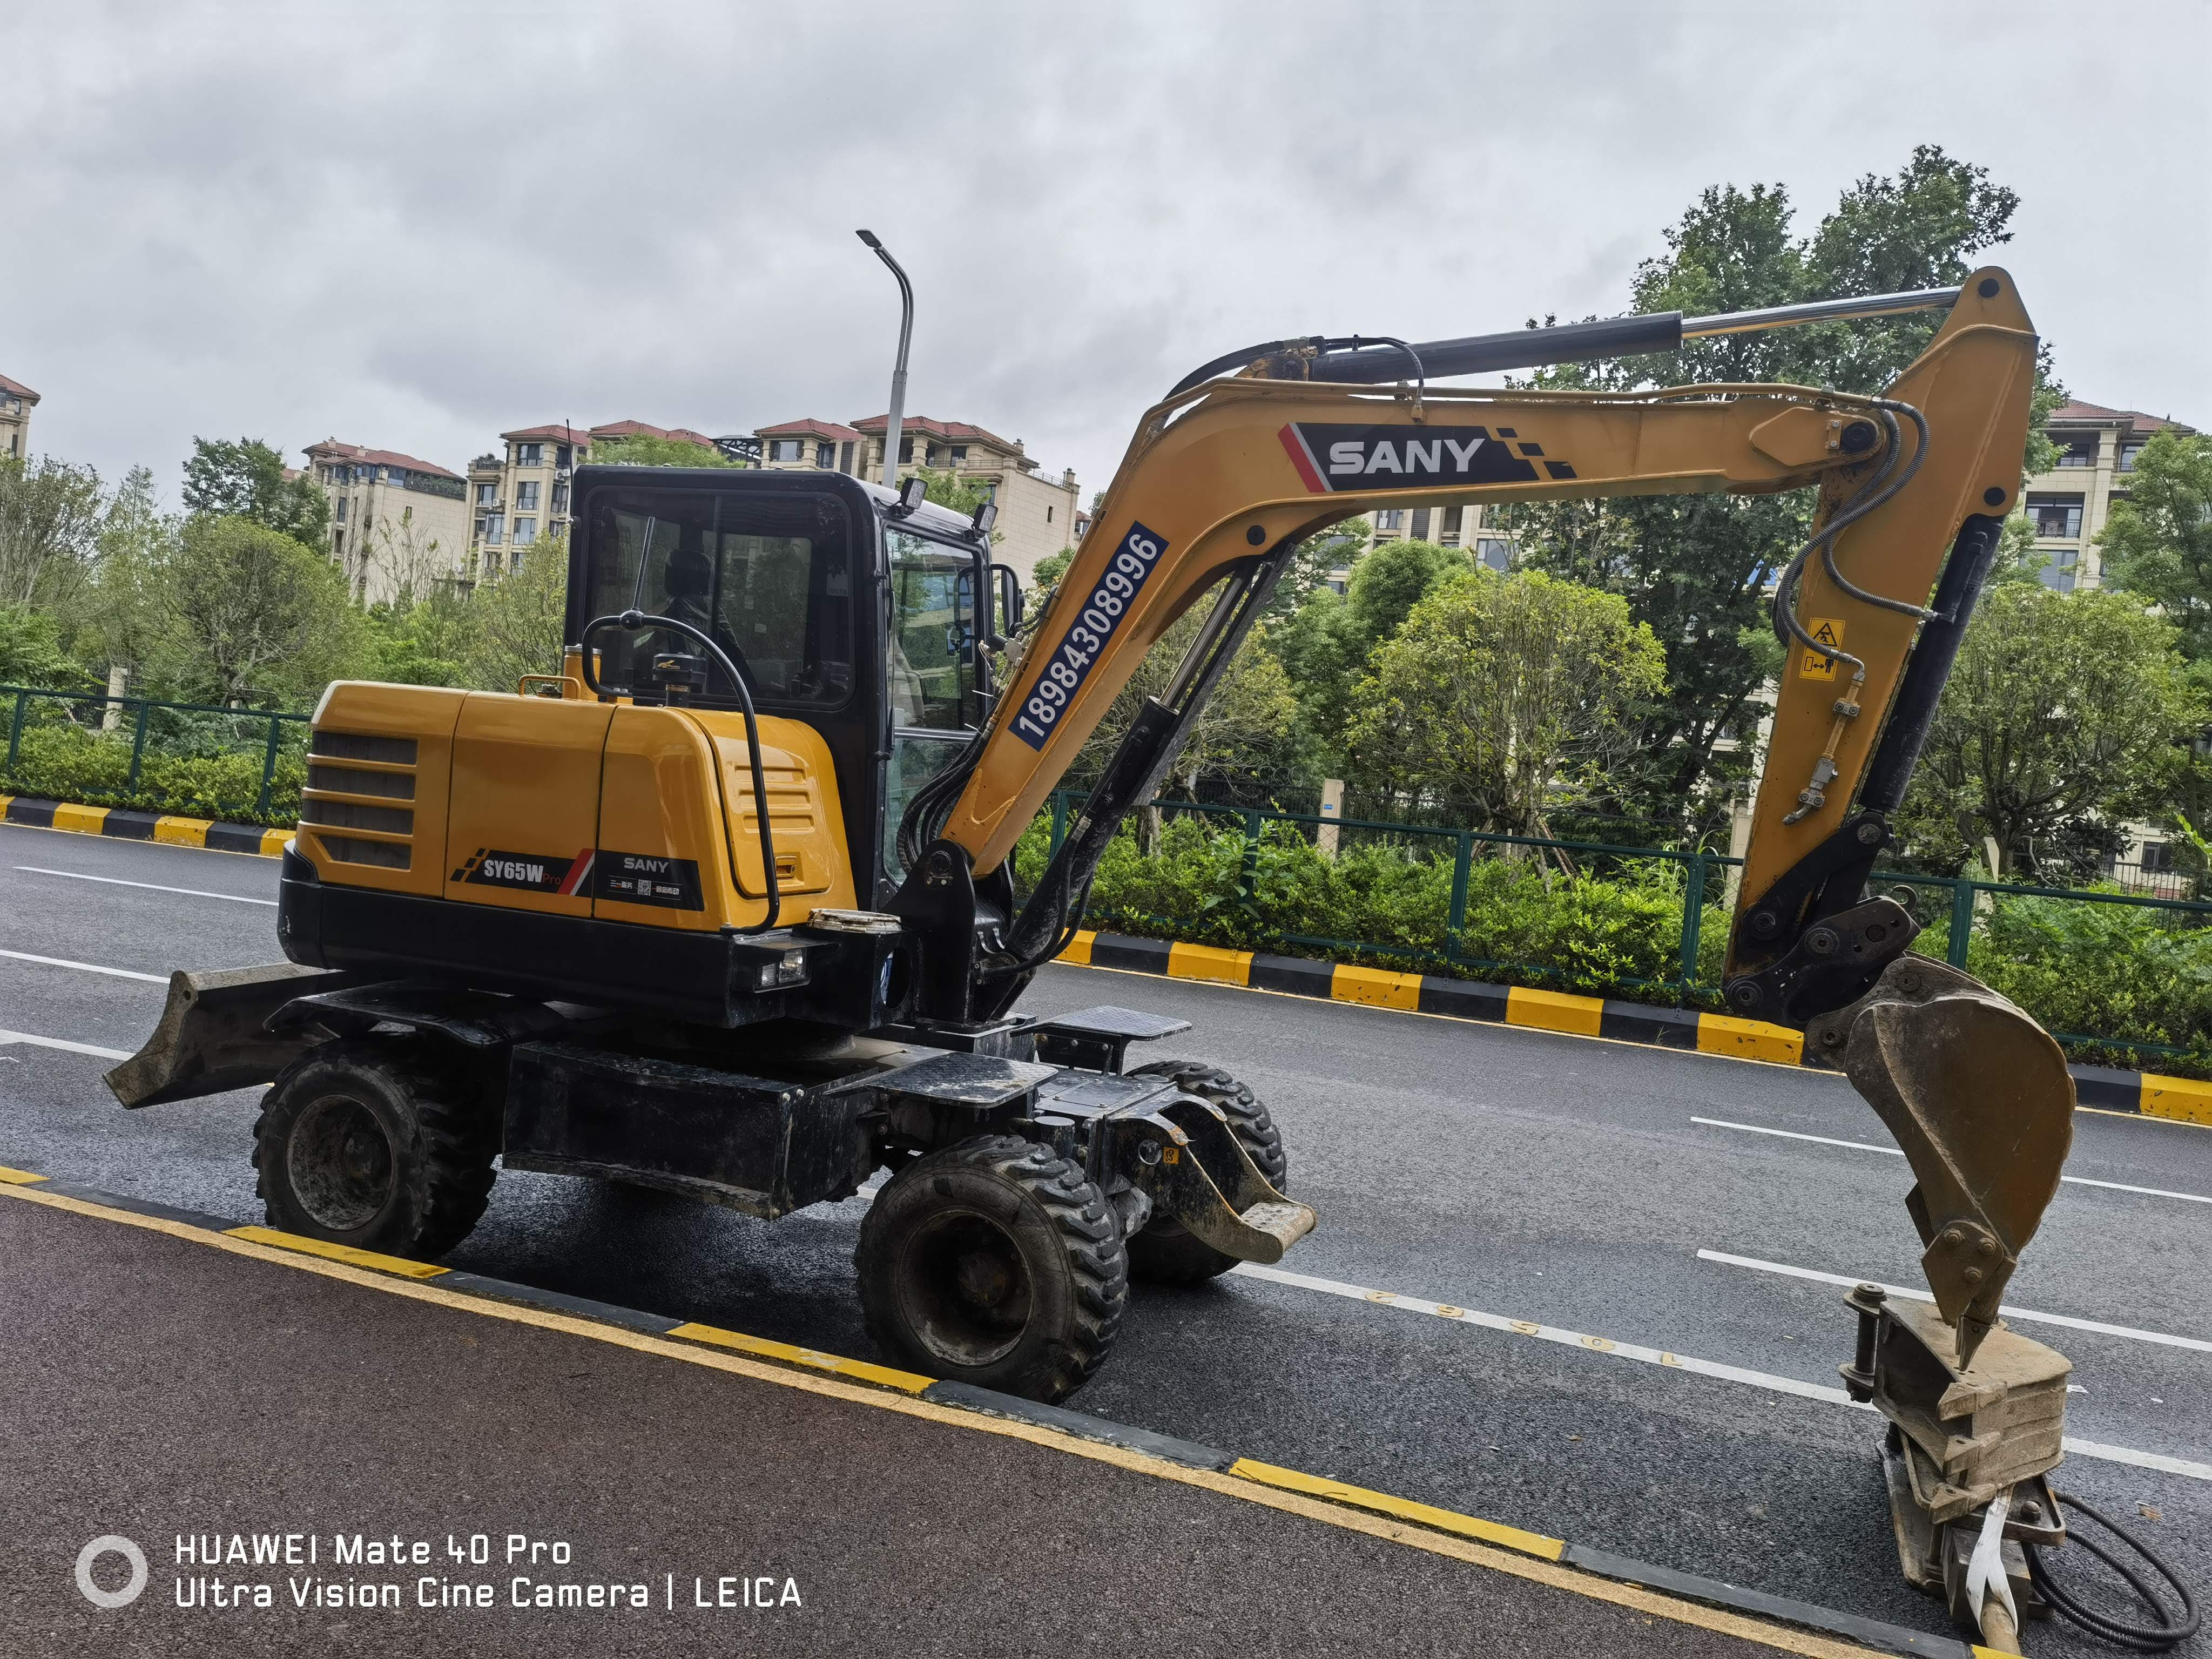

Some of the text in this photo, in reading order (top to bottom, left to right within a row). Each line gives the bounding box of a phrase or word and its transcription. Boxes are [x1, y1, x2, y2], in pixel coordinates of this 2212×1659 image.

[1329, 438, 1486, 475] SANY
[1019, 534, 1158, 738] 18984308996
[484, 859, 562, 885] SY65W Pro
[624, 857, 669, 873] SANY
